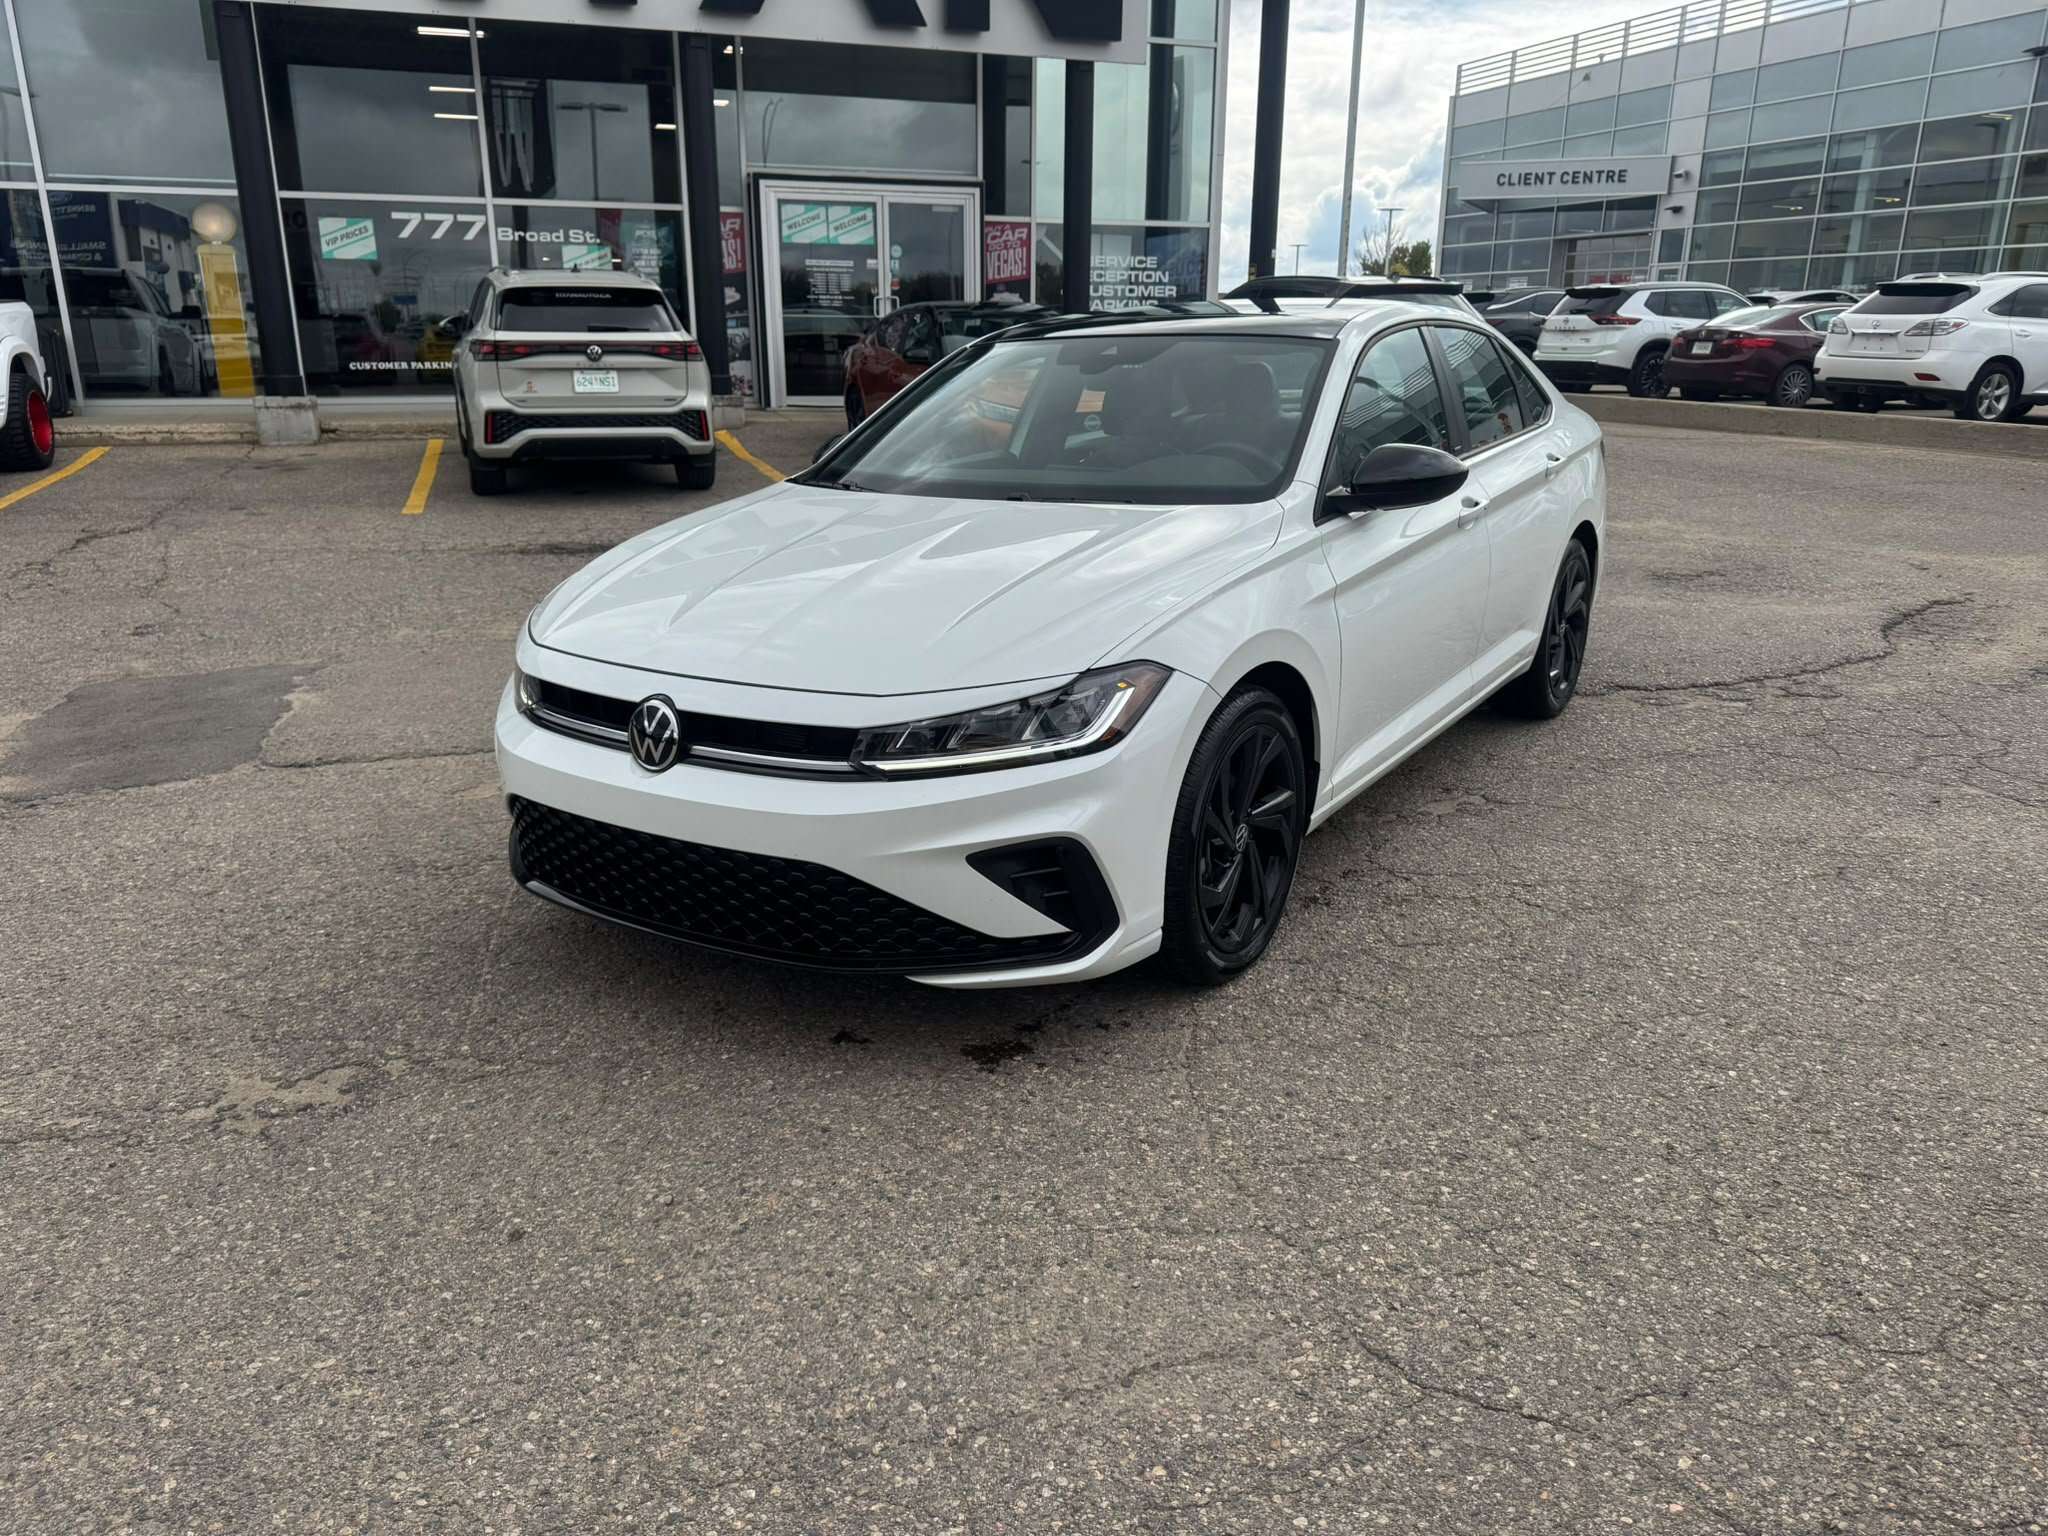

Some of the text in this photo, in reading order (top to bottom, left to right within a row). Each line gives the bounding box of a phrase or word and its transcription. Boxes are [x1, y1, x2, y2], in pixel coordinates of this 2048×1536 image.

[1496, 168, 1628, 187] CLIENT CENTRE
[391, 211, 601, 243] 777 Broad St.
[787, 211, 821, 231] WELCOME
[833, 213, 868, 232] WELCOME
[325, 225, 369, 247] VIP PRICES
[987, 227, 1028, 244] CAR
[987, 246, 1026, 280] VEGAS!
[1091, 255, 1158, 268] ERVICE
[1090, 271, 1170, 283] CEPTION
[1090, 285, 1177, 297] USTOMER
[349, 361, 408, 370] CUSTOMER
